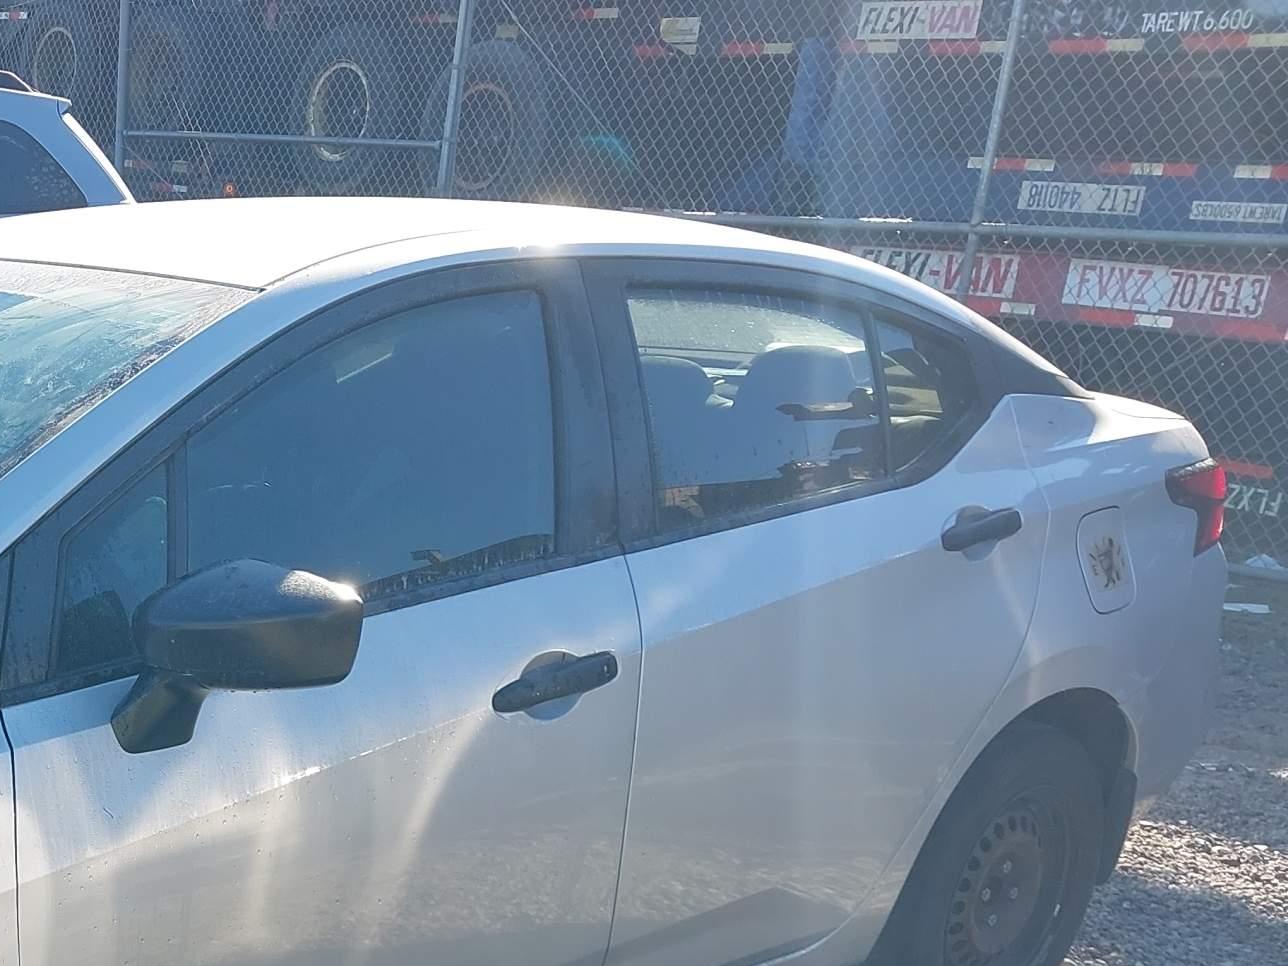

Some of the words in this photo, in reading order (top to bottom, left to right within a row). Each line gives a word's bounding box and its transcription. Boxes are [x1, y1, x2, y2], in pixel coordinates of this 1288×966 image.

[860, 5, 978, 35] FLEXI-VAN
[1075, 264, 1155, 306] FVXZ
[1166, 270, 1265, 316] 707613
